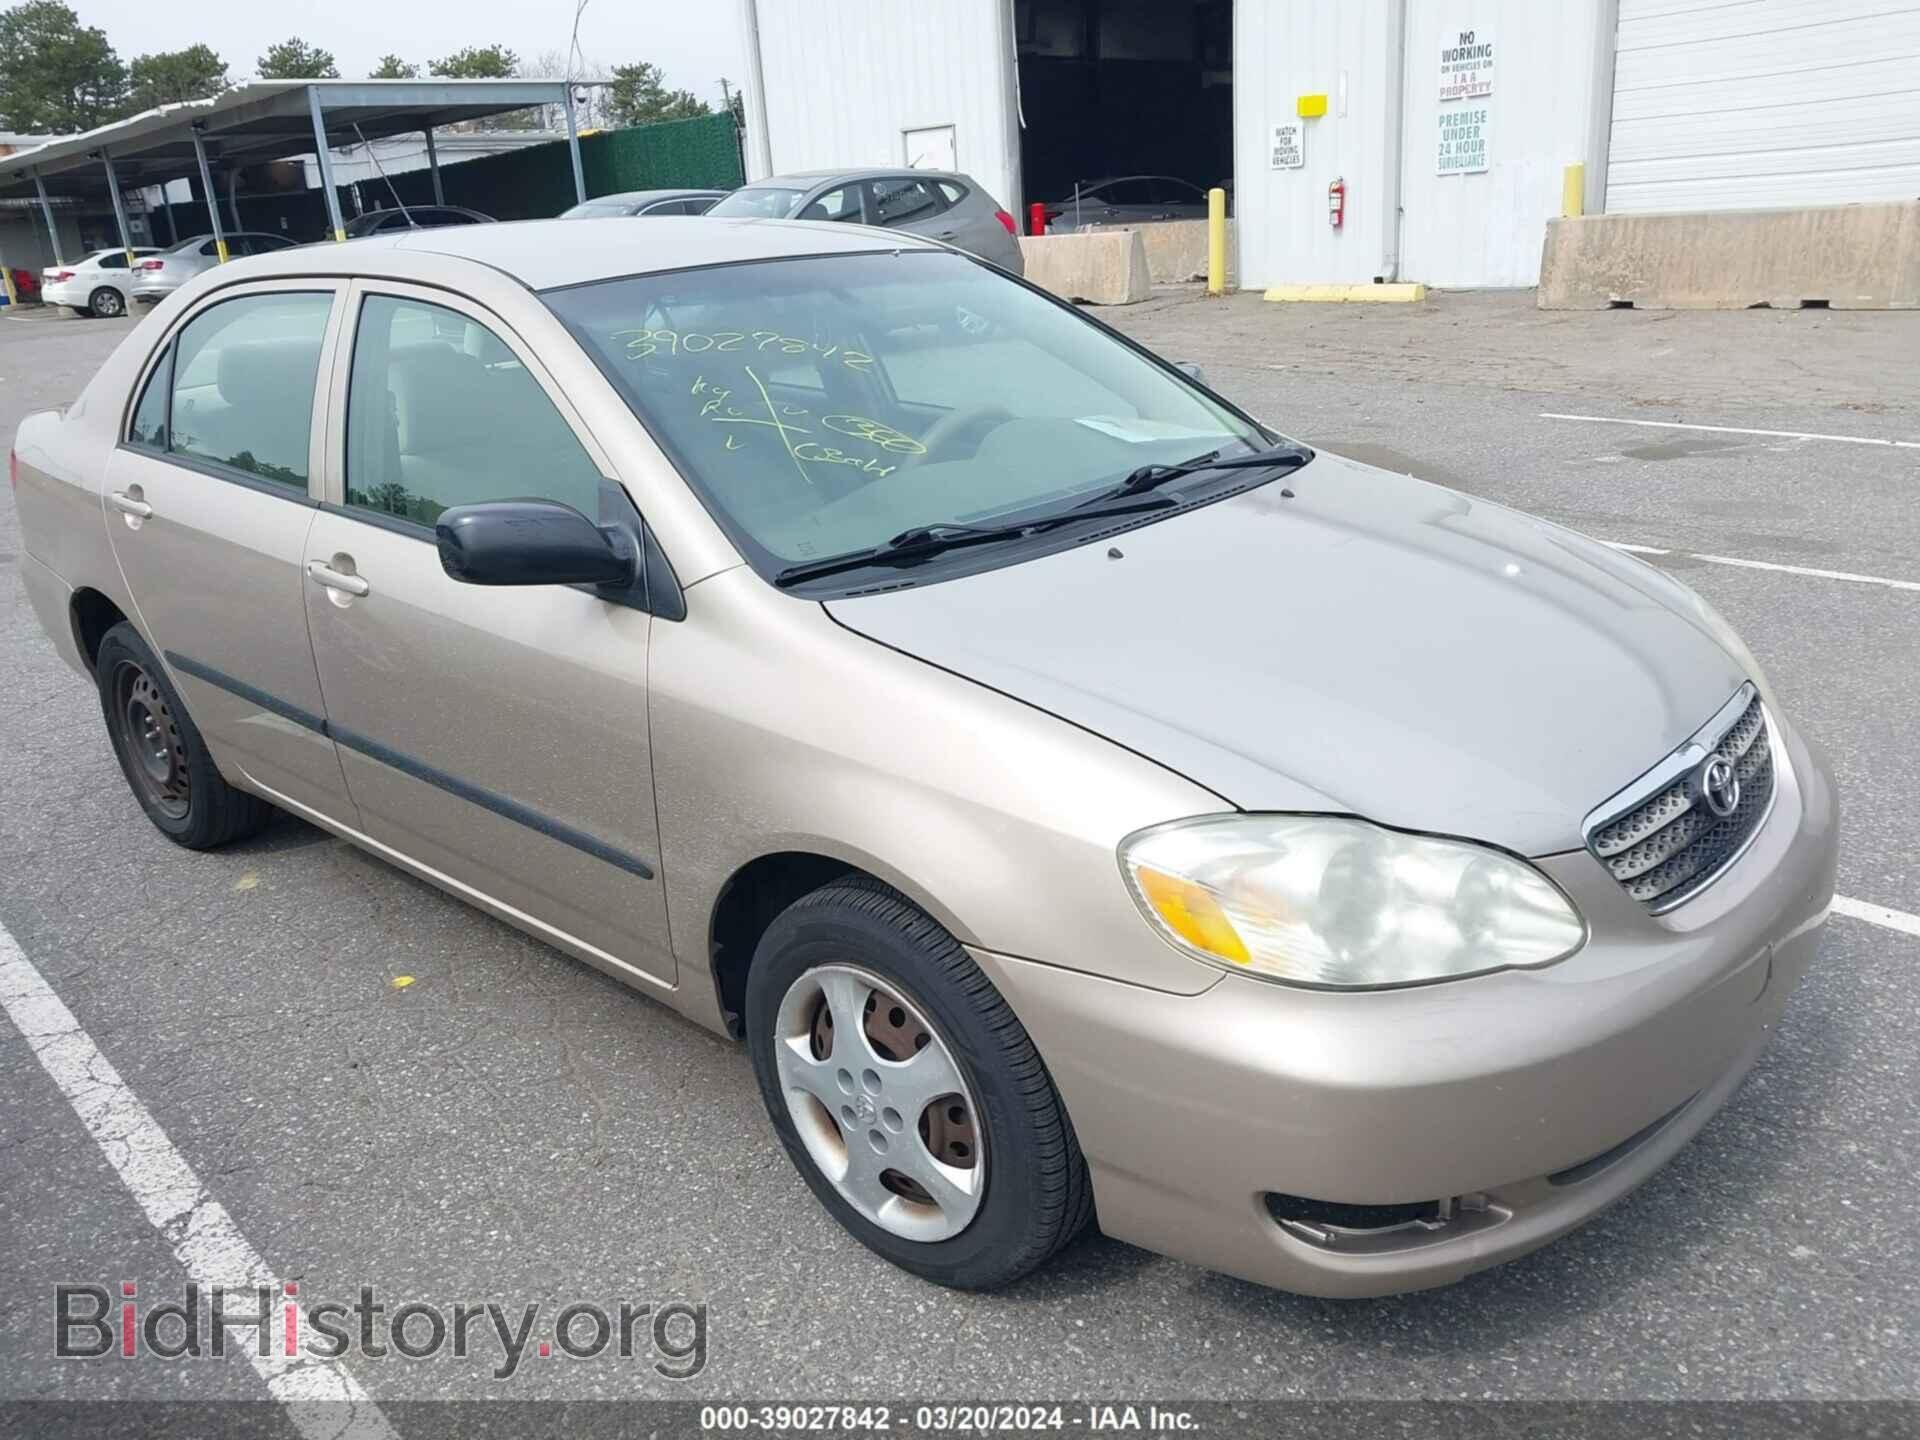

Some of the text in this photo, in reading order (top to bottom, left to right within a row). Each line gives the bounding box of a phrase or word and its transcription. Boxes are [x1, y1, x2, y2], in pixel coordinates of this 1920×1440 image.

[1459, 30, 1475, 46] NO
[1442, 43, 1492, 63] WORKING
[1440, 80, 1492, 97] PROPERTY
[1439, 110, 1487, 127] PREMISE
[1275, 126, 1296, 137] WATCH
[1443, 126, 1480, 142] UNDER
[1274, 145, 1298, 155] MOVING
[1438, 139, 1485, 156] 24 HOUR
[1272, 154, 1300, 166] VEHICLES
[610, 329, 873, 373] 39027842
